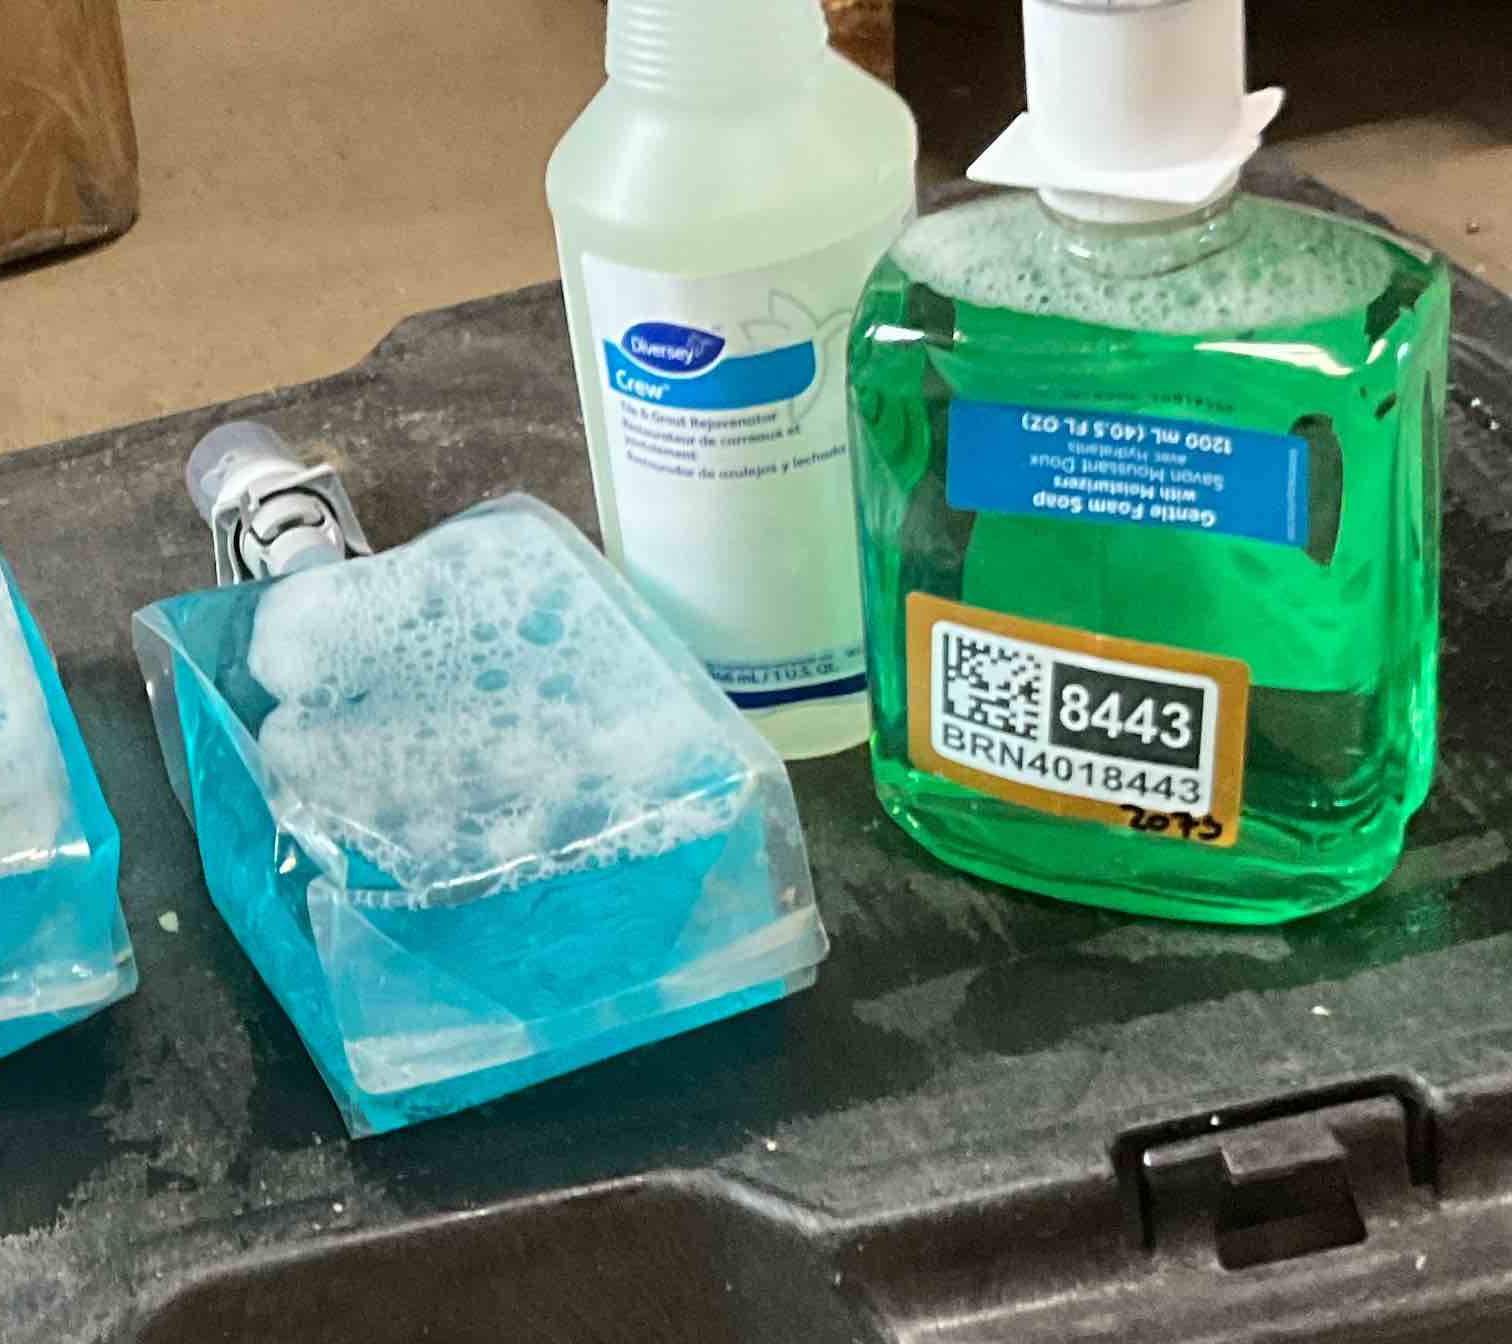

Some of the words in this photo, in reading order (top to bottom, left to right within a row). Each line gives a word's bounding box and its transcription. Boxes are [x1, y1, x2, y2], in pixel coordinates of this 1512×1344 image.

[631, 335, 694, 365] Diversey
[615, 369, 665, 400] Crew
[1021, 411, 1058, 432] OZ)
[1062, 417, 1088, 434] FL
[1091, 419, 1146, 441] (40.5
[1150, 427, 1181, 445] mL
[1185, 432, 1233, 454] 1200
[1029, 453, 1076, 473] Doux
[1081, 458, 1165, 483] Moussant
[1053, 475, 1155, 499] Moisturizers
[1169, 468, 1225, 490] Savon
[1031, 490, 1083, 514] Soap
[1158, 486, 1197, 503] with
[1086, 497, 1145, 521] Foam
[1149, 503, 1216, 528] Gentle
[1057, 682, 1195, 751] 8443
[940, 723, 1202, 806] BRN4018443
